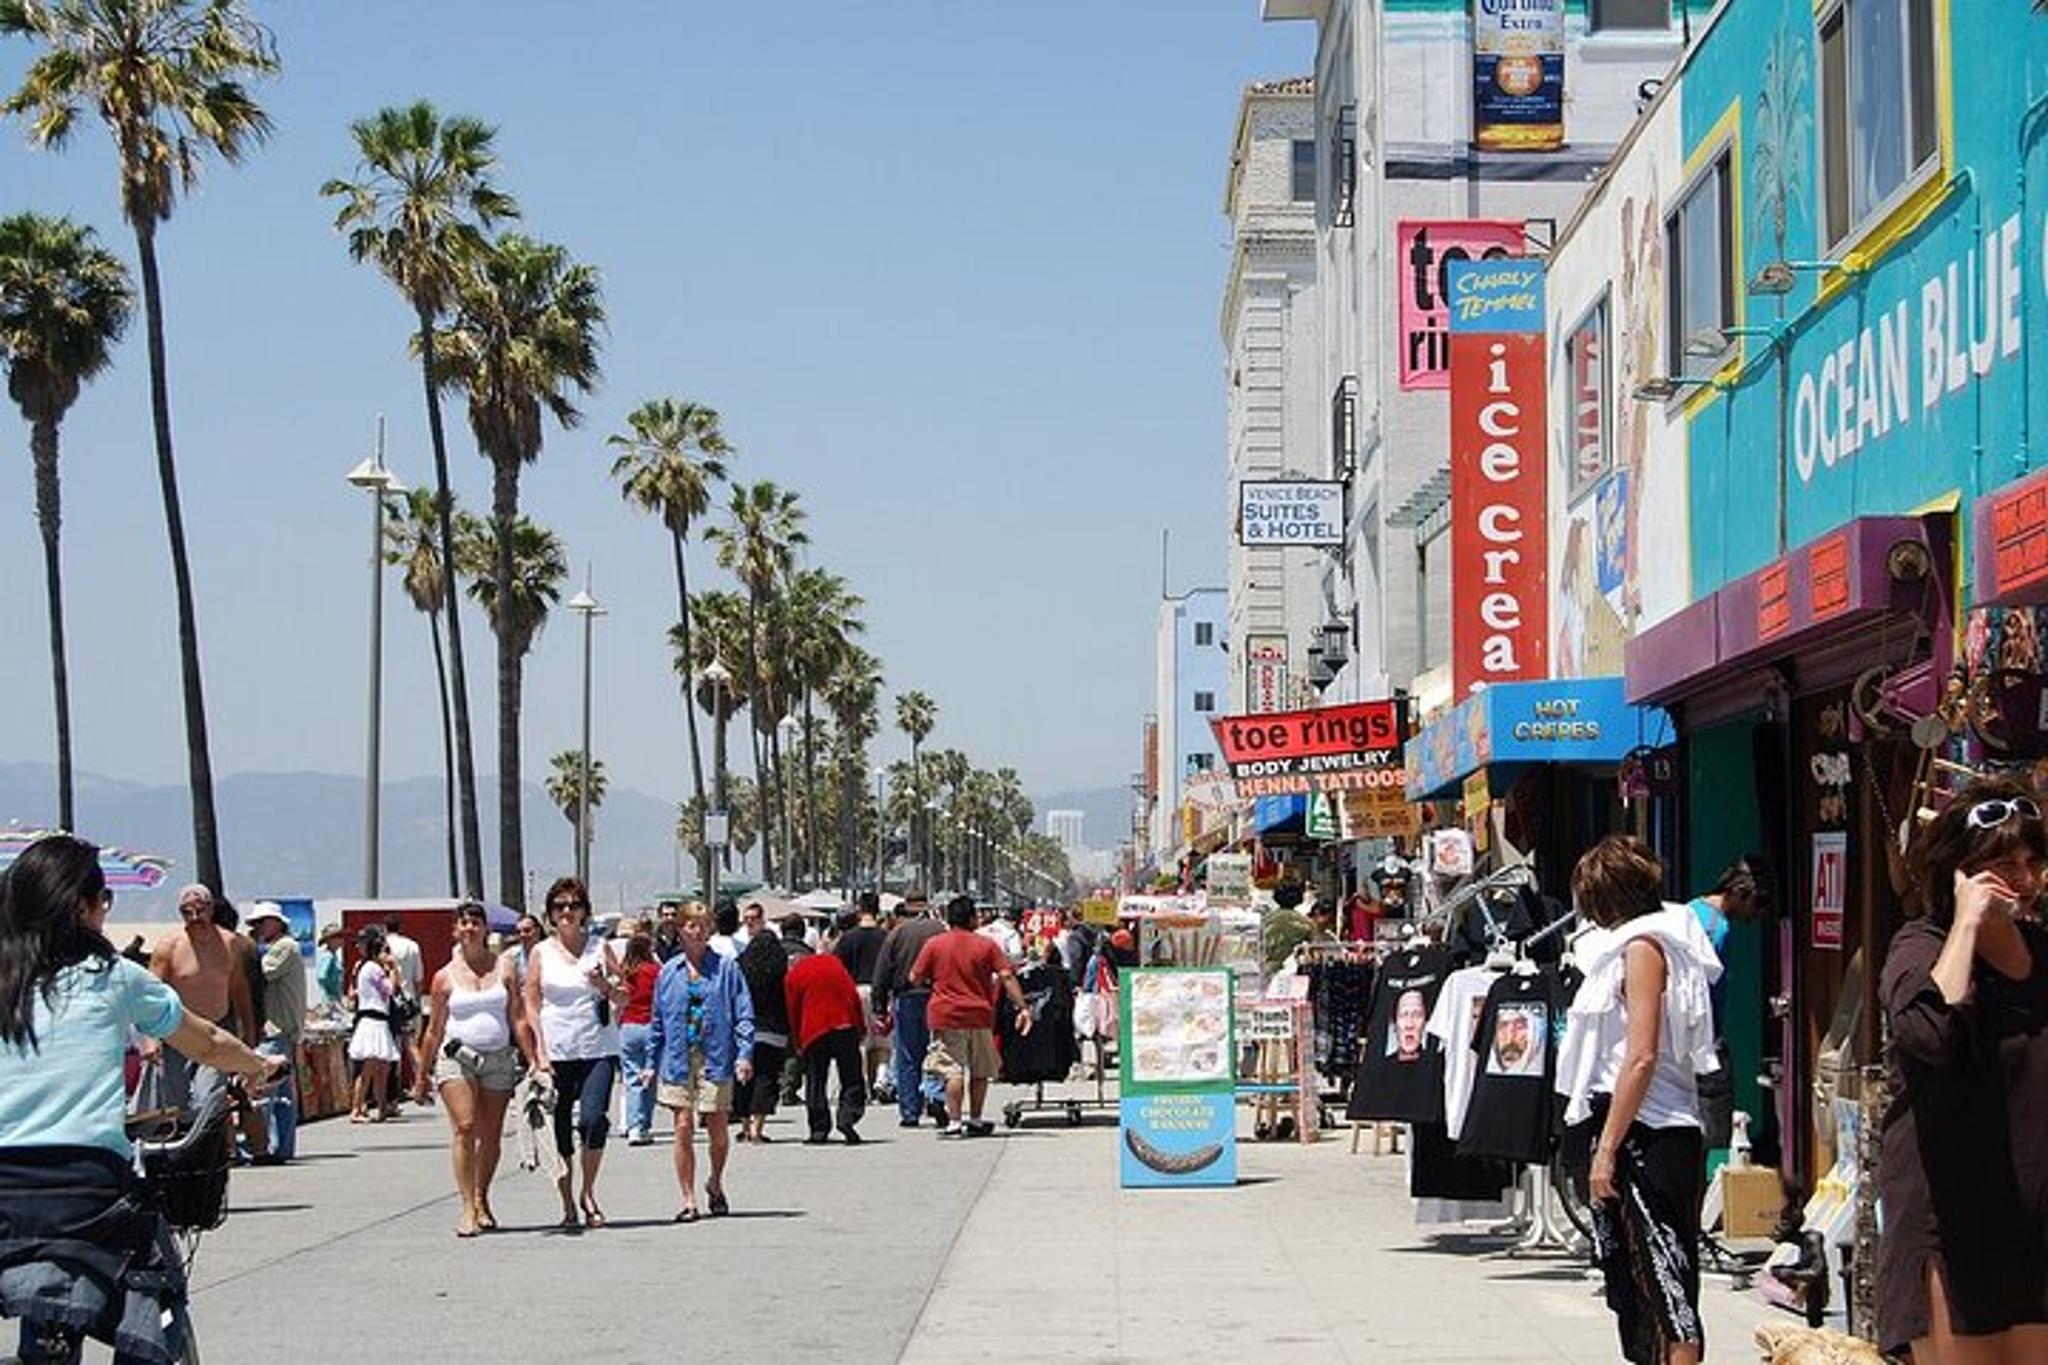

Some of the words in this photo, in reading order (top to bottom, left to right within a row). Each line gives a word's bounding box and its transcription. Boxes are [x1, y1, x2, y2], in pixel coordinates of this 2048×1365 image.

[1501, 14, 1542, 29] Extra
[1456, 271, 1536, 293] CHARLY
[1794, 299, 1910, 483] OCEAN
[1922, 212, 2021, 410] BLUE
[1478, 343, 1520, 482] ice
[1247, 488, 1293, 500] VENICE
[1245, 503, 1320, 520] SUITES
[1248, 522, 1263, 538] &
[1268, 521, 1341, 538] HOTEL
[1469, 503, 1523, 695] crea
[1533, 699, 1580, 717] HOT
[1231, 723, 1289, 751] toe
[1301, 712, 1390, 747] rings
[1513, 721, 1600, 742] CREPES
[1237, 758, 1293, 777] BODY
[1299, 750, 1391, 772] JEWELRY
[1238, 774, 1311, 797] HENNA
[1315, 768, 1408, 792] TATTOOS
